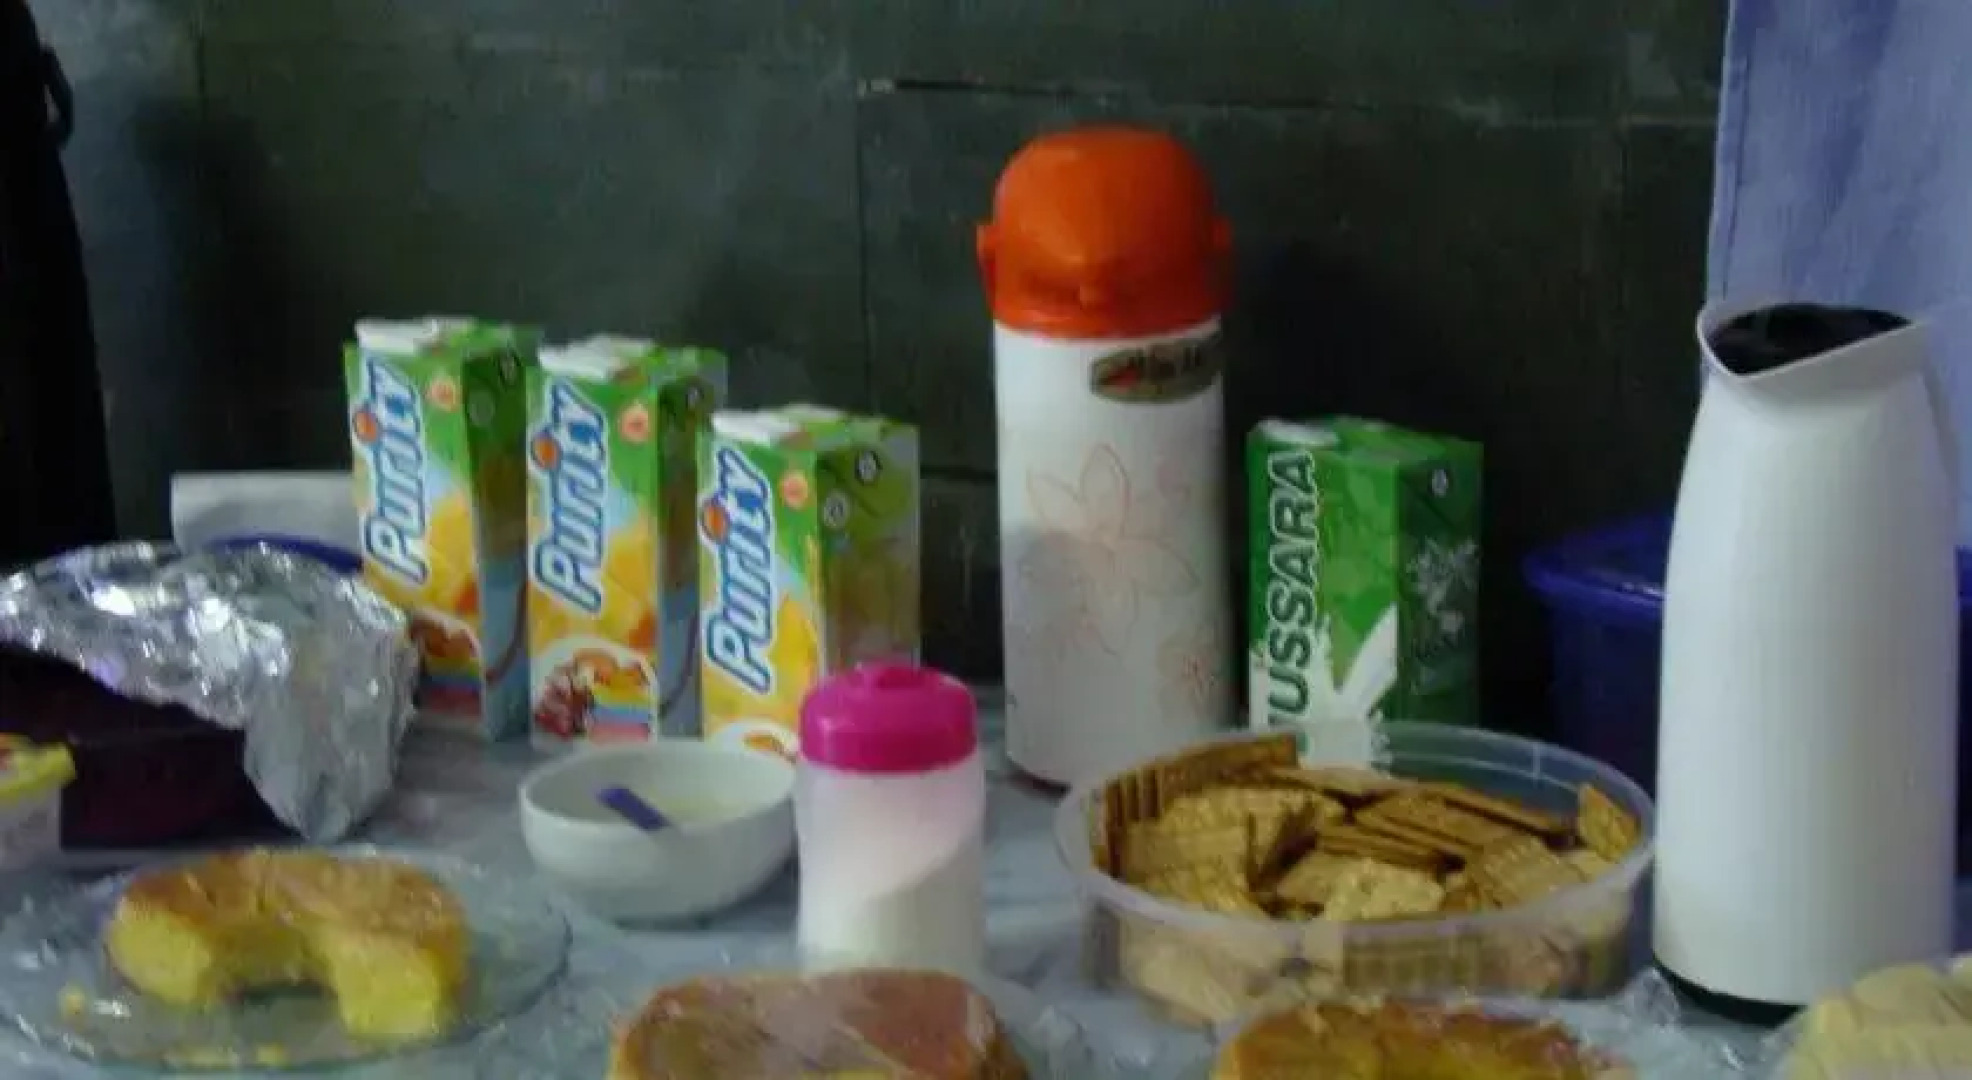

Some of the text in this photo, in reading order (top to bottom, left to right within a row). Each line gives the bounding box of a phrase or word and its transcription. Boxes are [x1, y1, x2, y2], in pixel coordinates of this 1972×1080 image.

[352, 358, 426, 584] Purity
[530, 381, 605, 613] Purity
[700, 447, 773, 693] Purity
